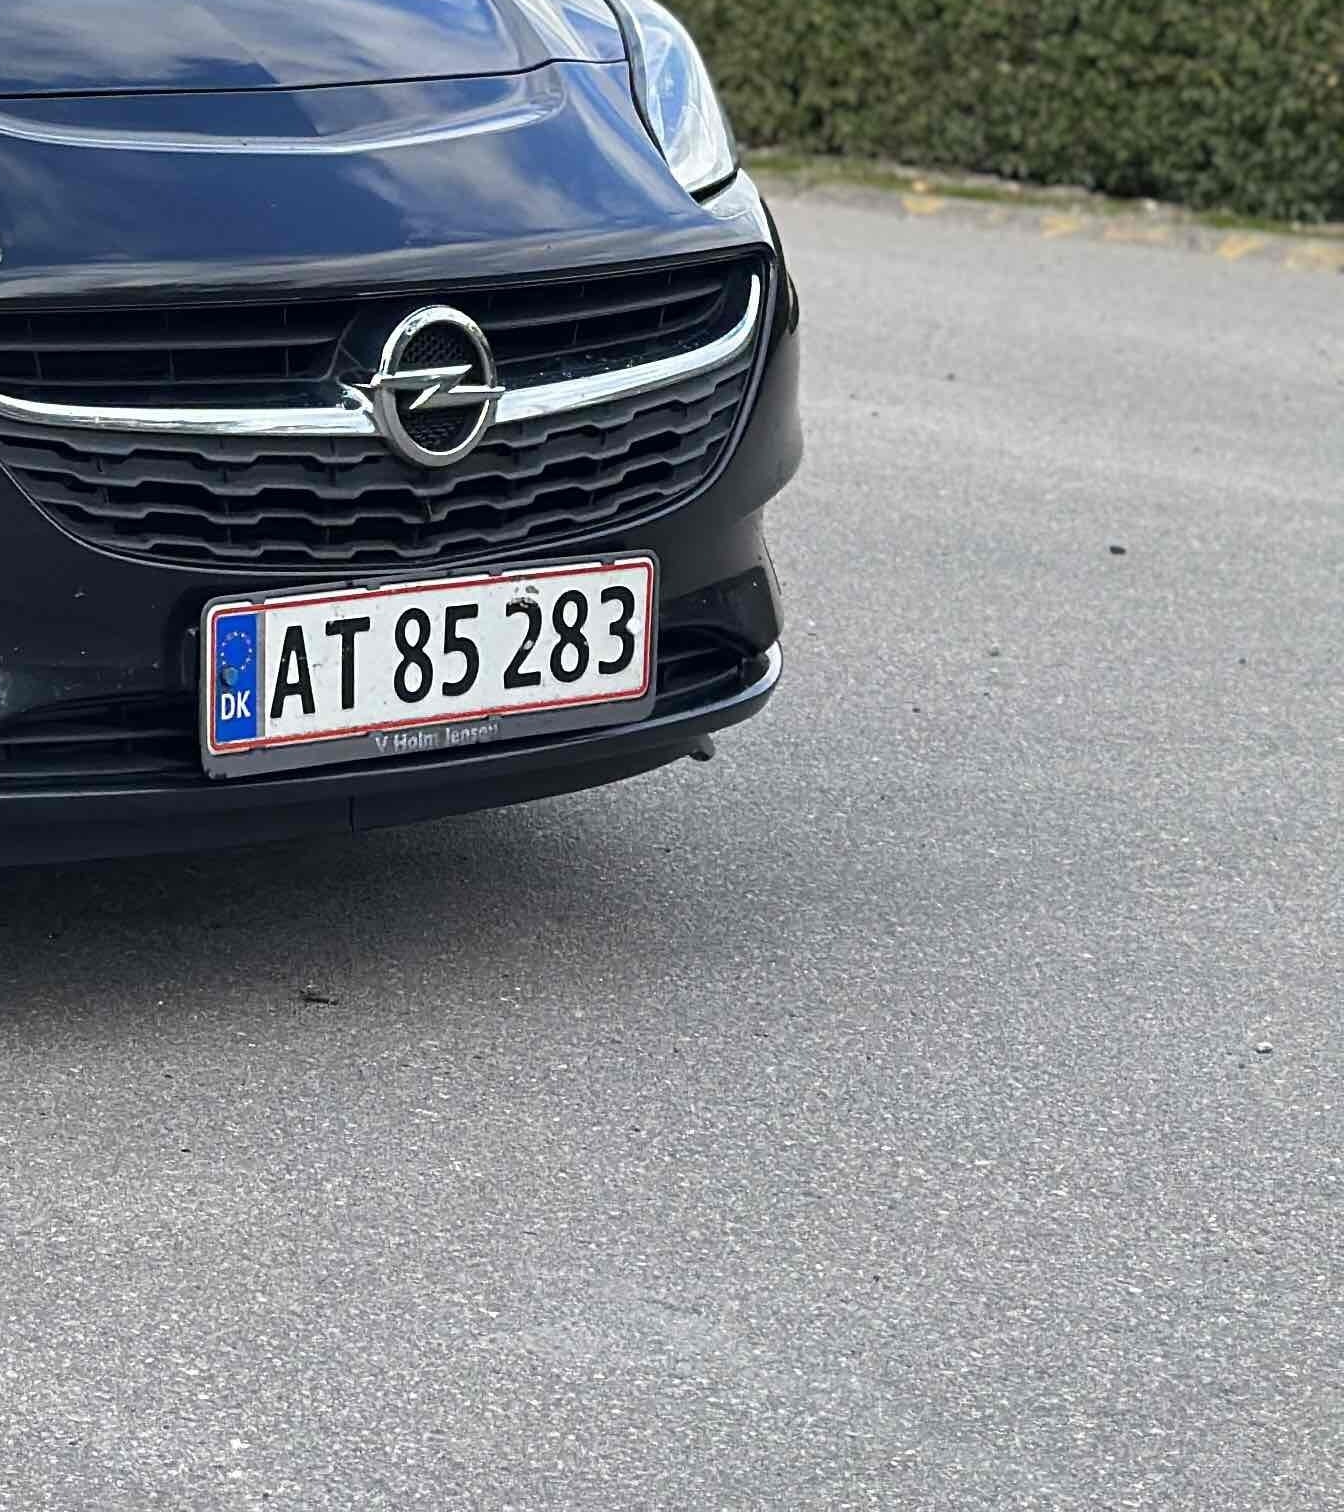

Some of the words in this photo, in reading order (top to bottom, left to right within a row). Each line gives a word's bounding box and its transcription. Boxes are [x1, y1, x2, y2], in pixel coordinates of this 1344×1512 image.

[269, 616, 371, 719] AT
[393, 603, 480, 704] 85
[503, 585, 635, 689] 283
[221, 690, 252, 721] DK
